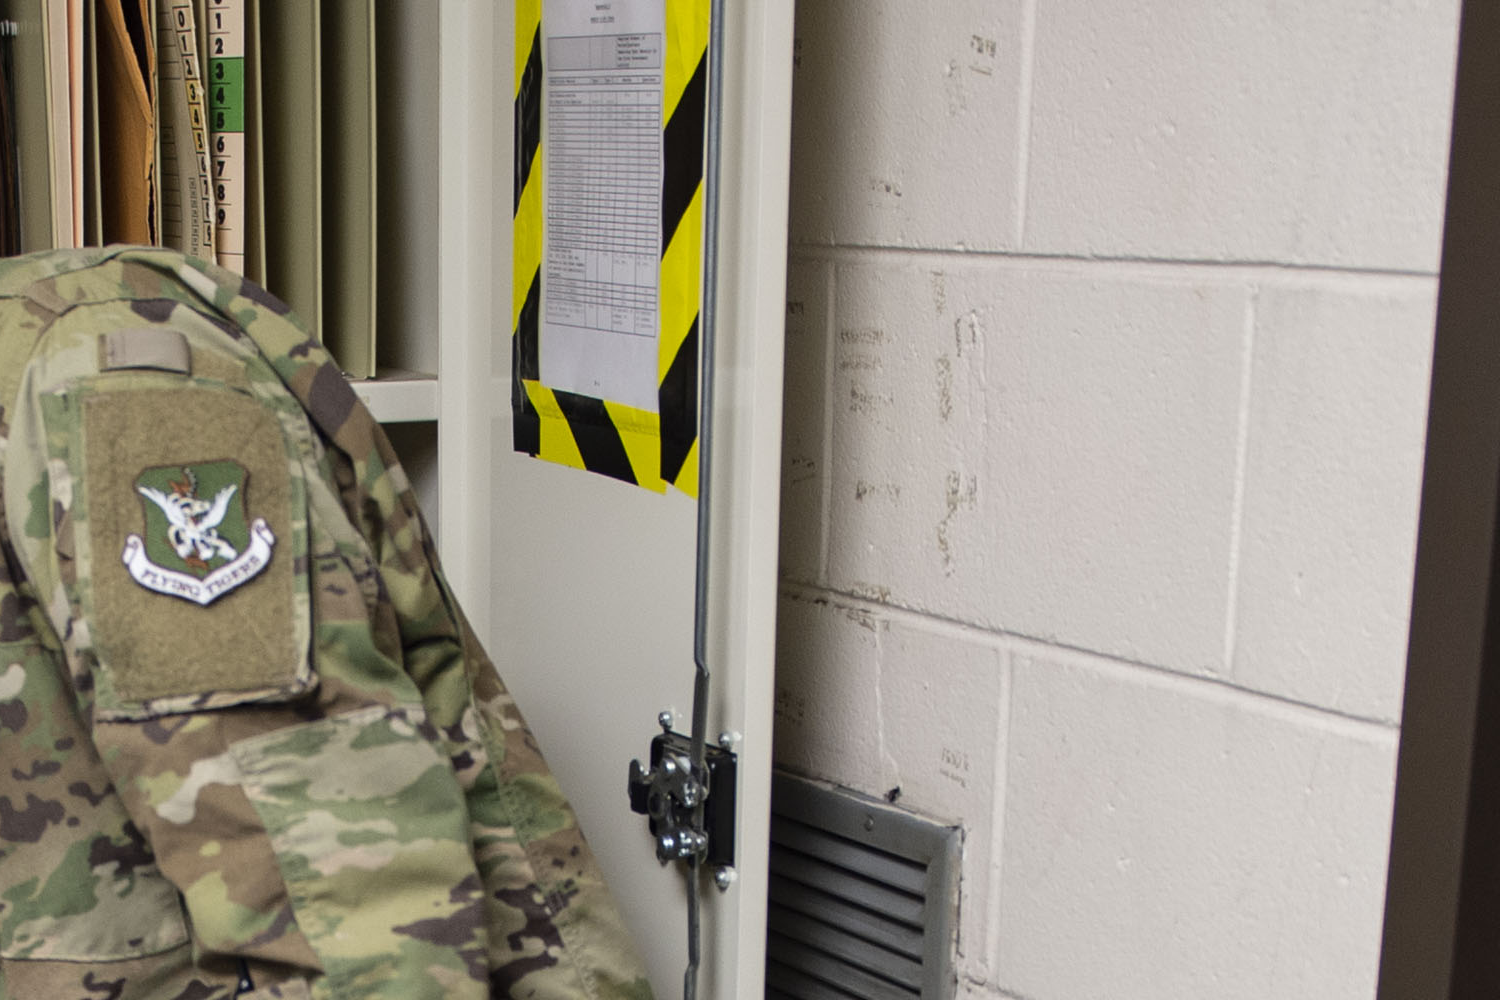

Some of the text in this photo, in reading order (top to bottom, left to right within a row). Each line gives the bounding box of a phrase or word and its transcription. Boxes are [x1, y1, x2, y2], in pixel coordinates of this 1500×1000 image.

[215, 13, 226, 225] 1 2 3 4 5 6 7 8 9
[141, 557, 260, 596] FLYING TIGERS
